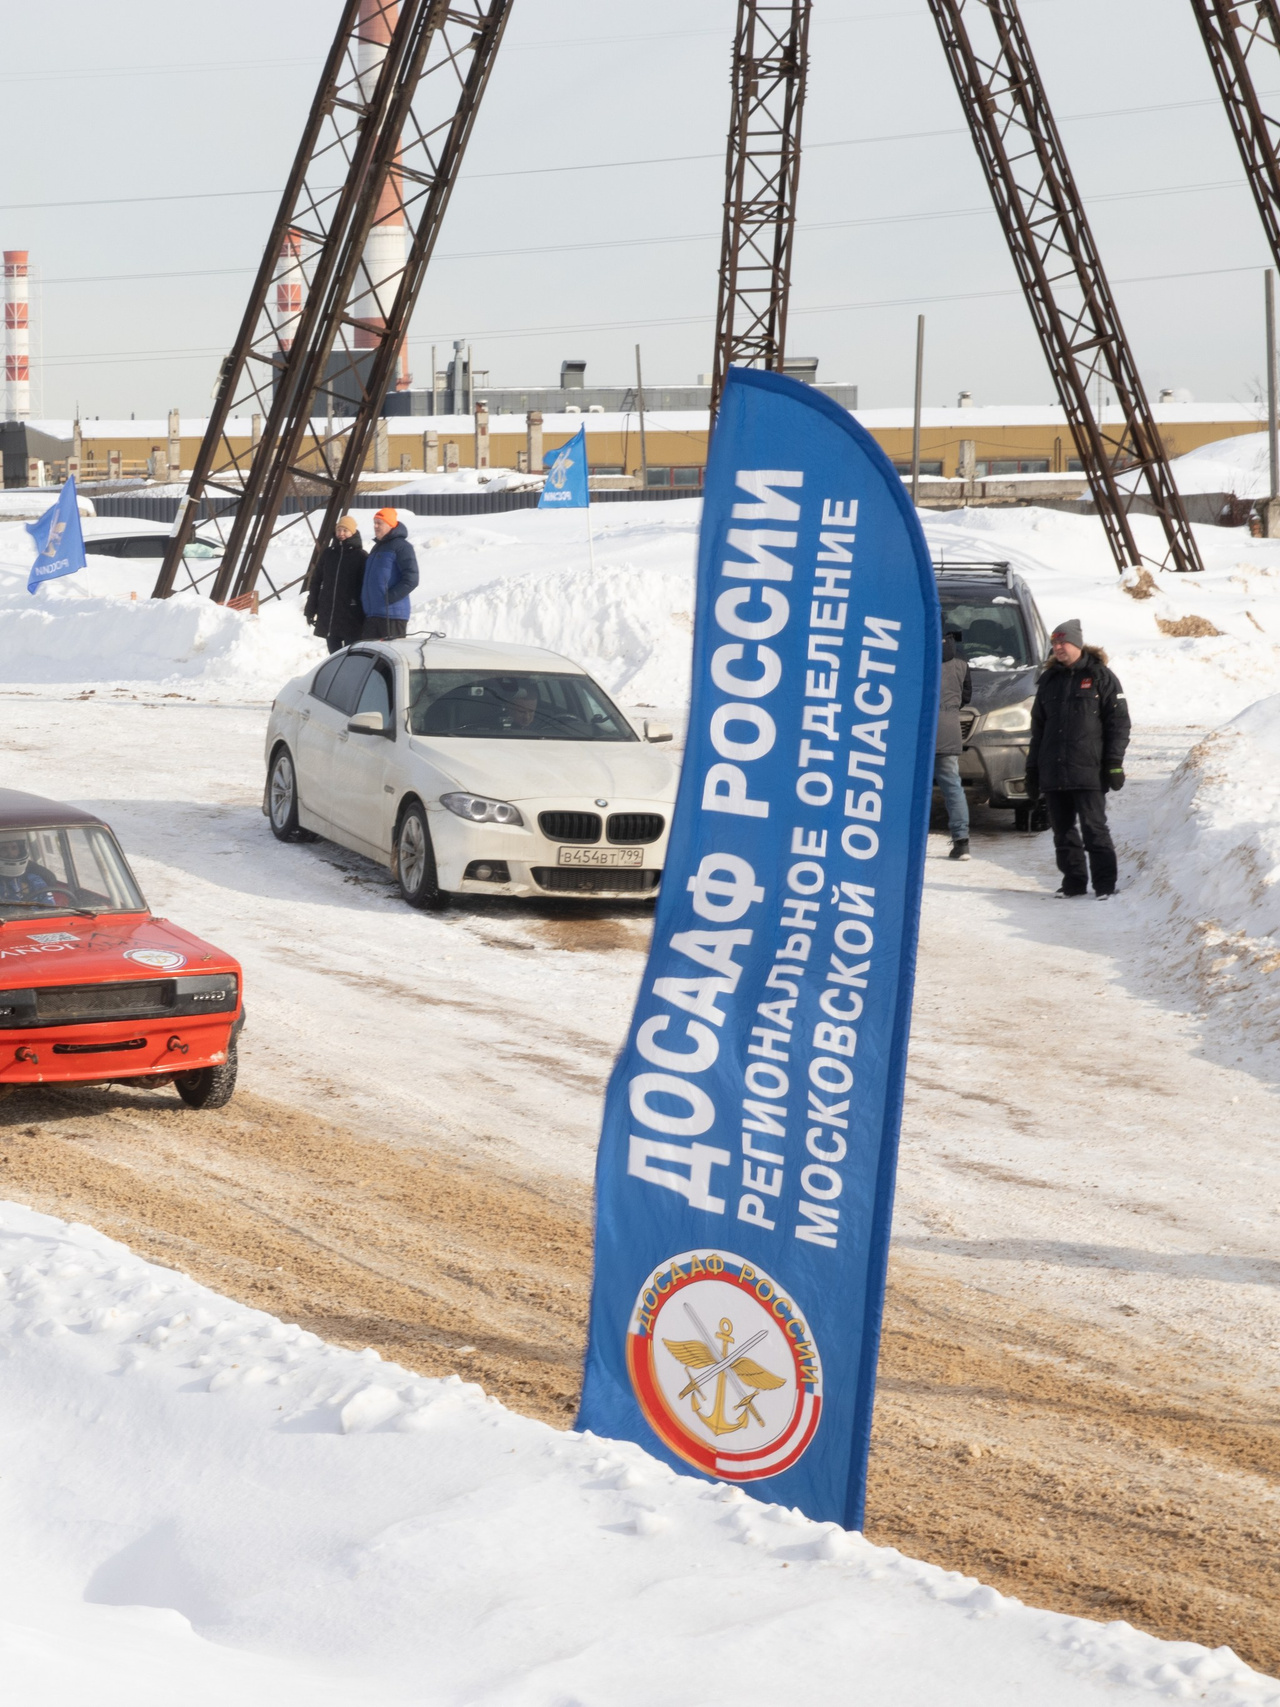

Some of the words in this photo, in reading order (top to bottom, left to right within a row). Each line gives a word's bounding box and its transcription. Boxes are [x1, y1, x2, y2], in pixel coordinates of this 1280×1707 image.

[564, 850, 617, 864] В454ВТ
[620, 850, 639, 861] 799
[627, 852, 765, 1215] ДОСААФ
[701, 470, 804, 818] РОССИИ
[737, 826, 828, 1231] РЕГИОНАЛЬНОЕ
[796, 498, 859, 806] ОТДЕЛЕНИЕ
[794, 881, 875, 1249] МОСКОВСКОЙ
[841, 616, 902, 860] ОБЛАСТИ
[635, 1254, 725, 1334] ДОСААФ
[738, 1263, 819, 1384] РОССИИ
